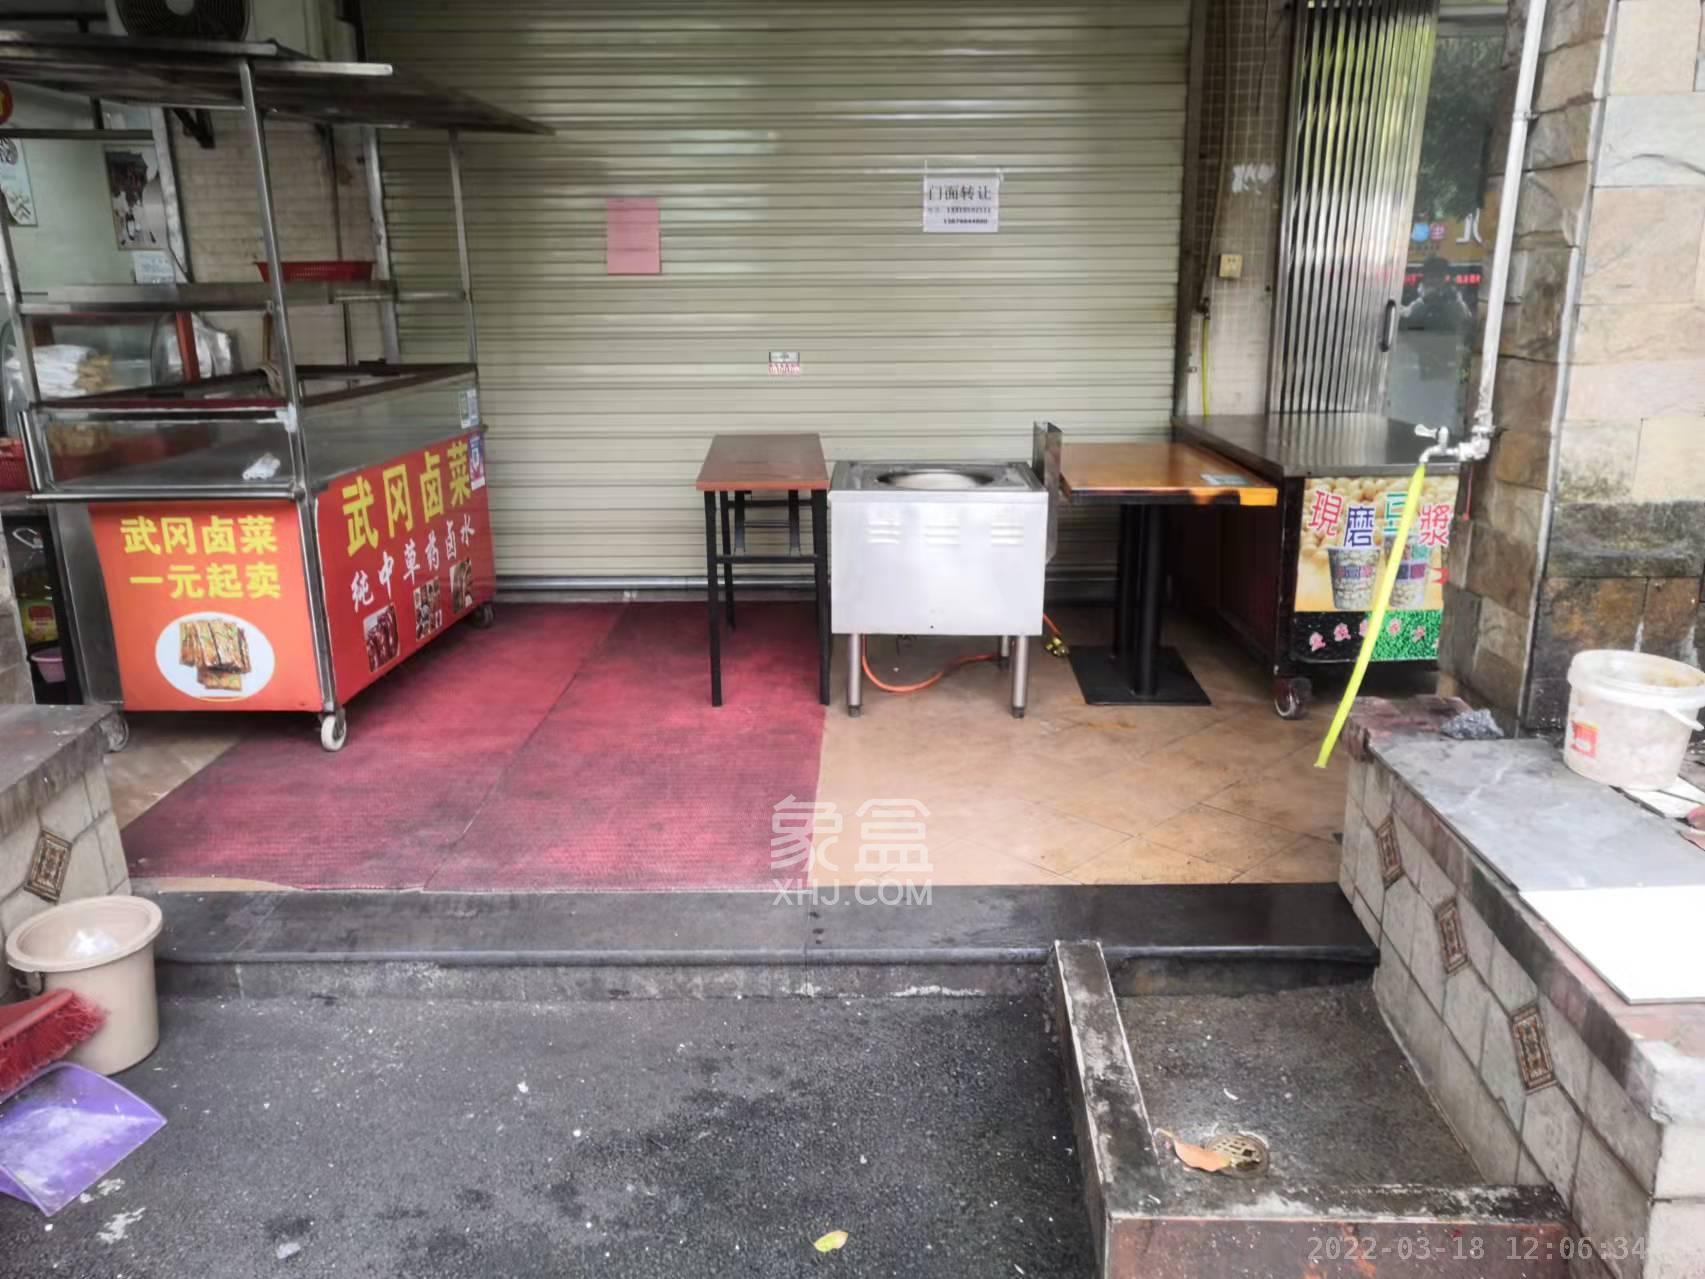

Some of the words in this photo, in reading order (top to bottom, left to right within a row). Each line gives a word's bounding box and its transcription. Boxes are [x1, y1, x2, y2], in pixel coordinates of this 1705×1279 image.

[928, 184, 992, 201] 门面转让
[342, 440, 471, 557] 武冈卤菜
[120, 515, 278, 555] 武冈卤菜
[129, 562, 281, 599] 一元起卖
[351, 513, 475, 613] 纯中草药卤水
